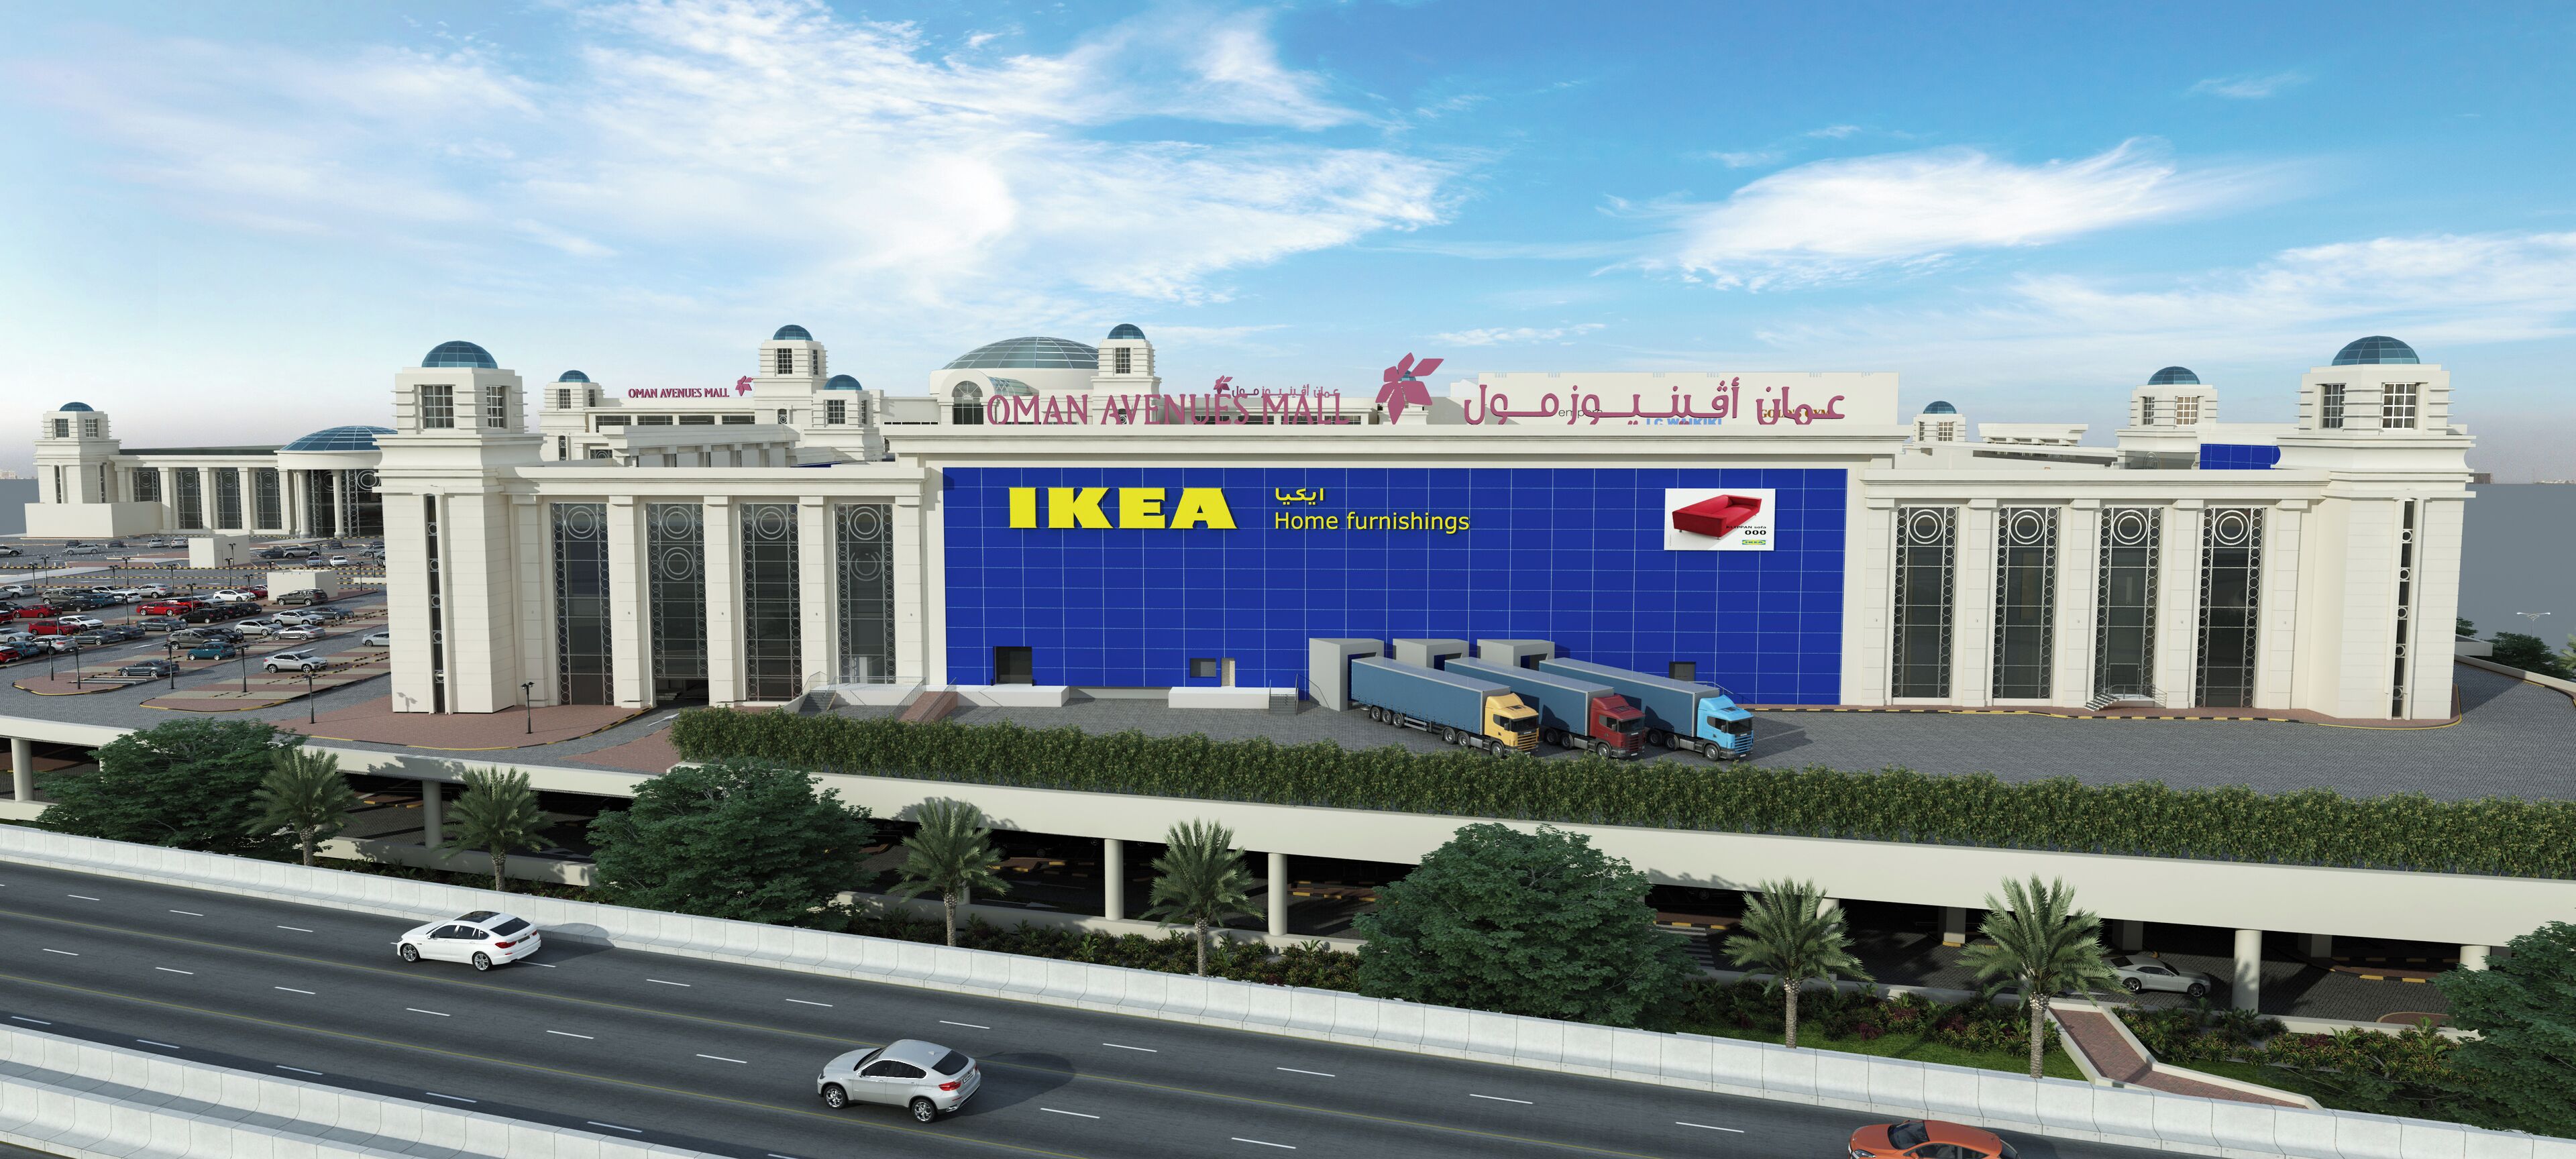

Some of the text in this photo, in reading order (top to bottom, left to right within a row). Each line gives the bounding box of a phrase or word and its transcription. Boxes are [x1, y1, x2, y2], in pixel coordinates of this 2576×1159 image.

[628, 388, 730, 398] OMAN AVENUES MALL
[1756, 386, 1845, 425] عمان
[987, 393, 1350, 425] OMAN AVENUES MALL
[1009, 488, 1237, 529] IKEA
[1275, 488, 1324, 506] ايكيا
[1275, 511, 1470, 535] Home furnishings
